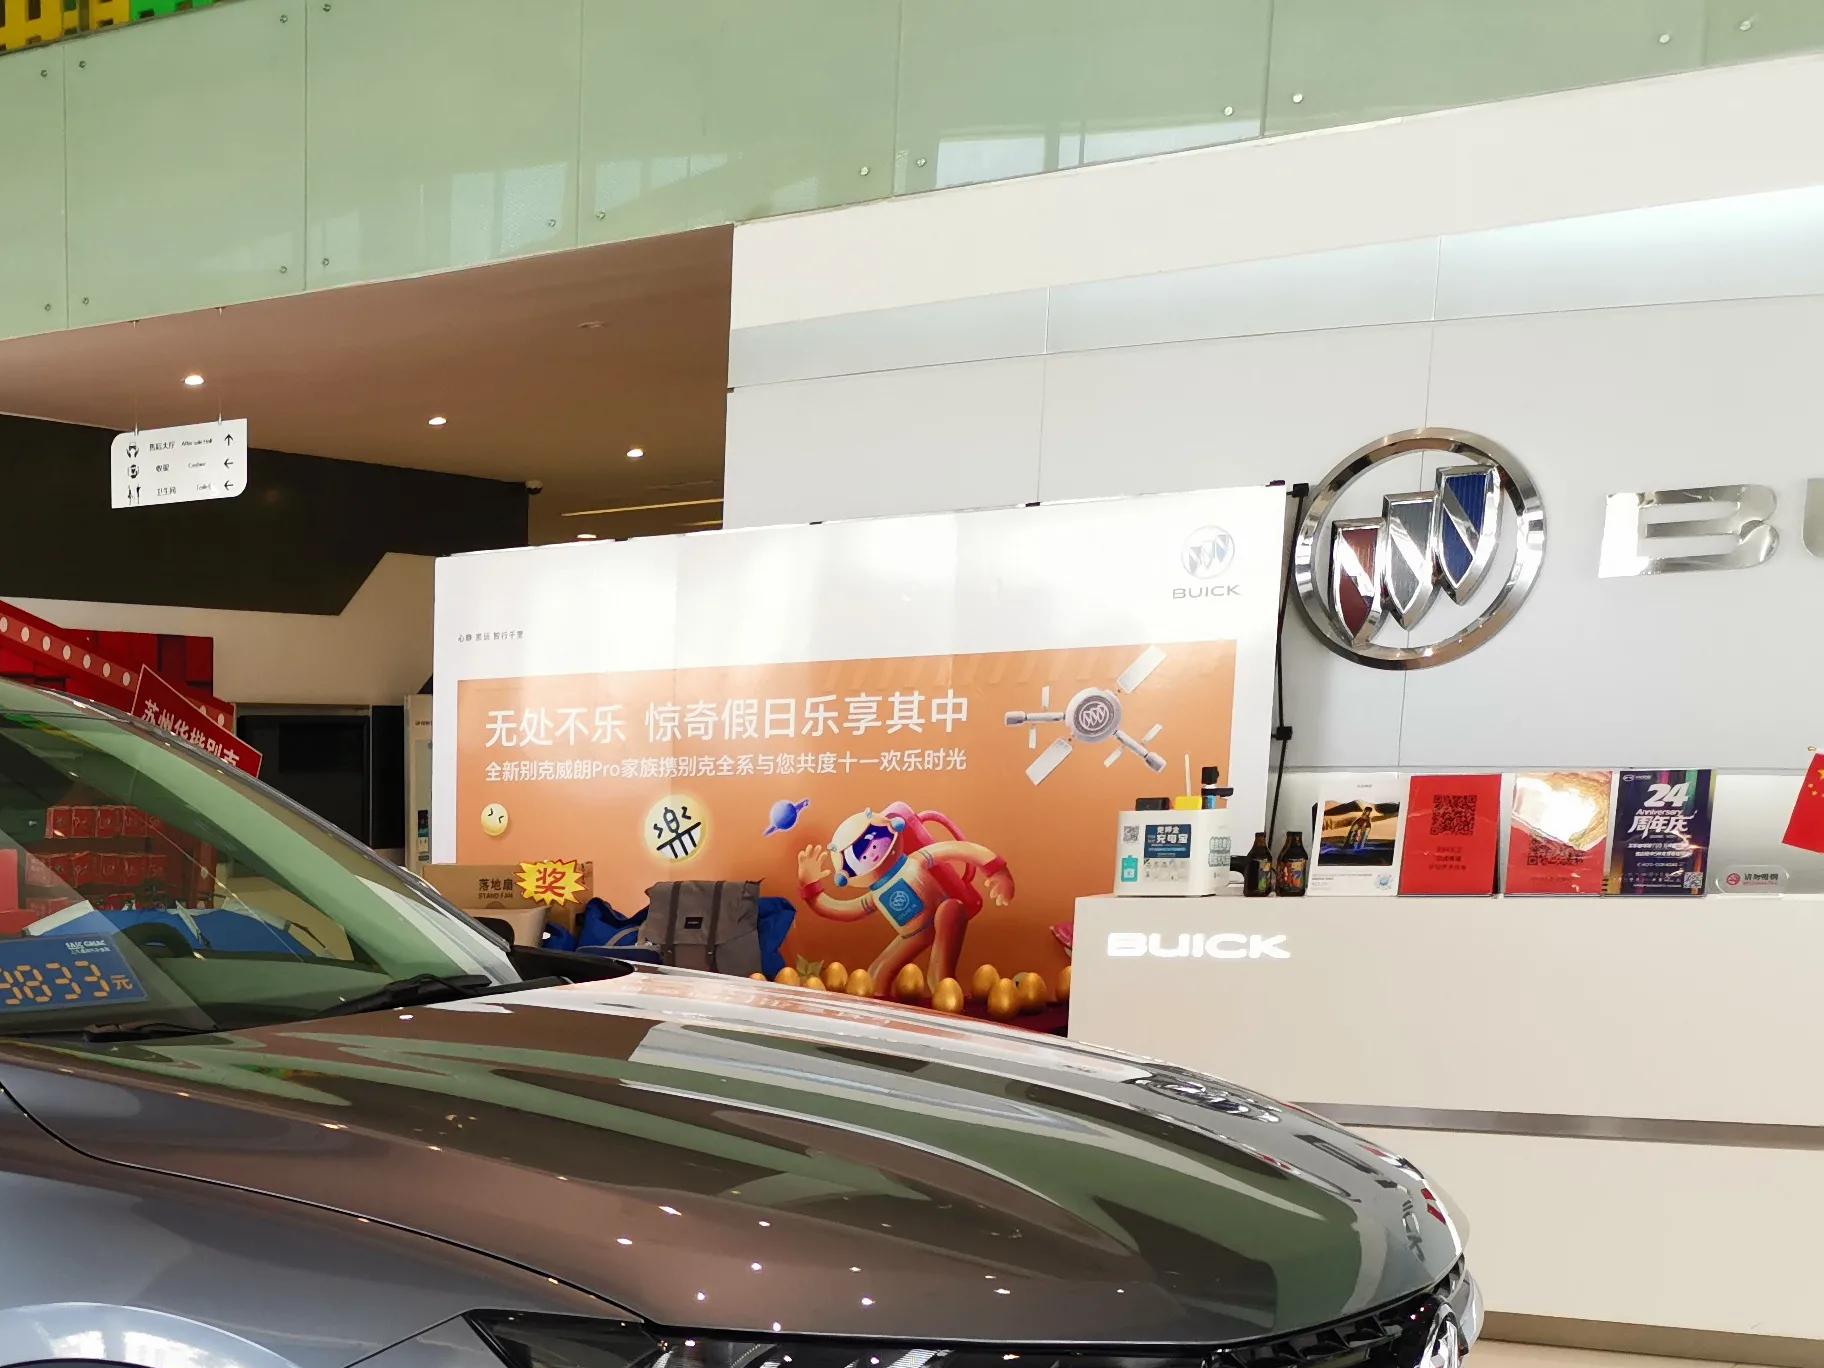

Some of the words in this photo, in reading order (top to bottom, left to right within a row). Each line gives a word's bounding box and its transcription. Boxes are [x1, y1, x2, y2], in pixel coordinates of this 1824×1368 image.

[1598, 478, 1824, 578] B
[1173, 584, 1241, 600] BUICK
[485, 703, 626, 748] 无处不乐
[644, 688, 968, 743] 惊奇假日乐享其中
[485, 747, 967, 782] 全新别克威朗Pro家族携别克全系与您共度十一欢乐时光
[1643, 782, 1689, 808] 24
[1635, 808, 1684, 817] Anniversary
[1628, 813, 1692, 839] 周年庆
[478, 879, 514, 892] 落地扇
[536, 868, 566, 898] 奖
[1107, 932, 1291, 959] BUICK
